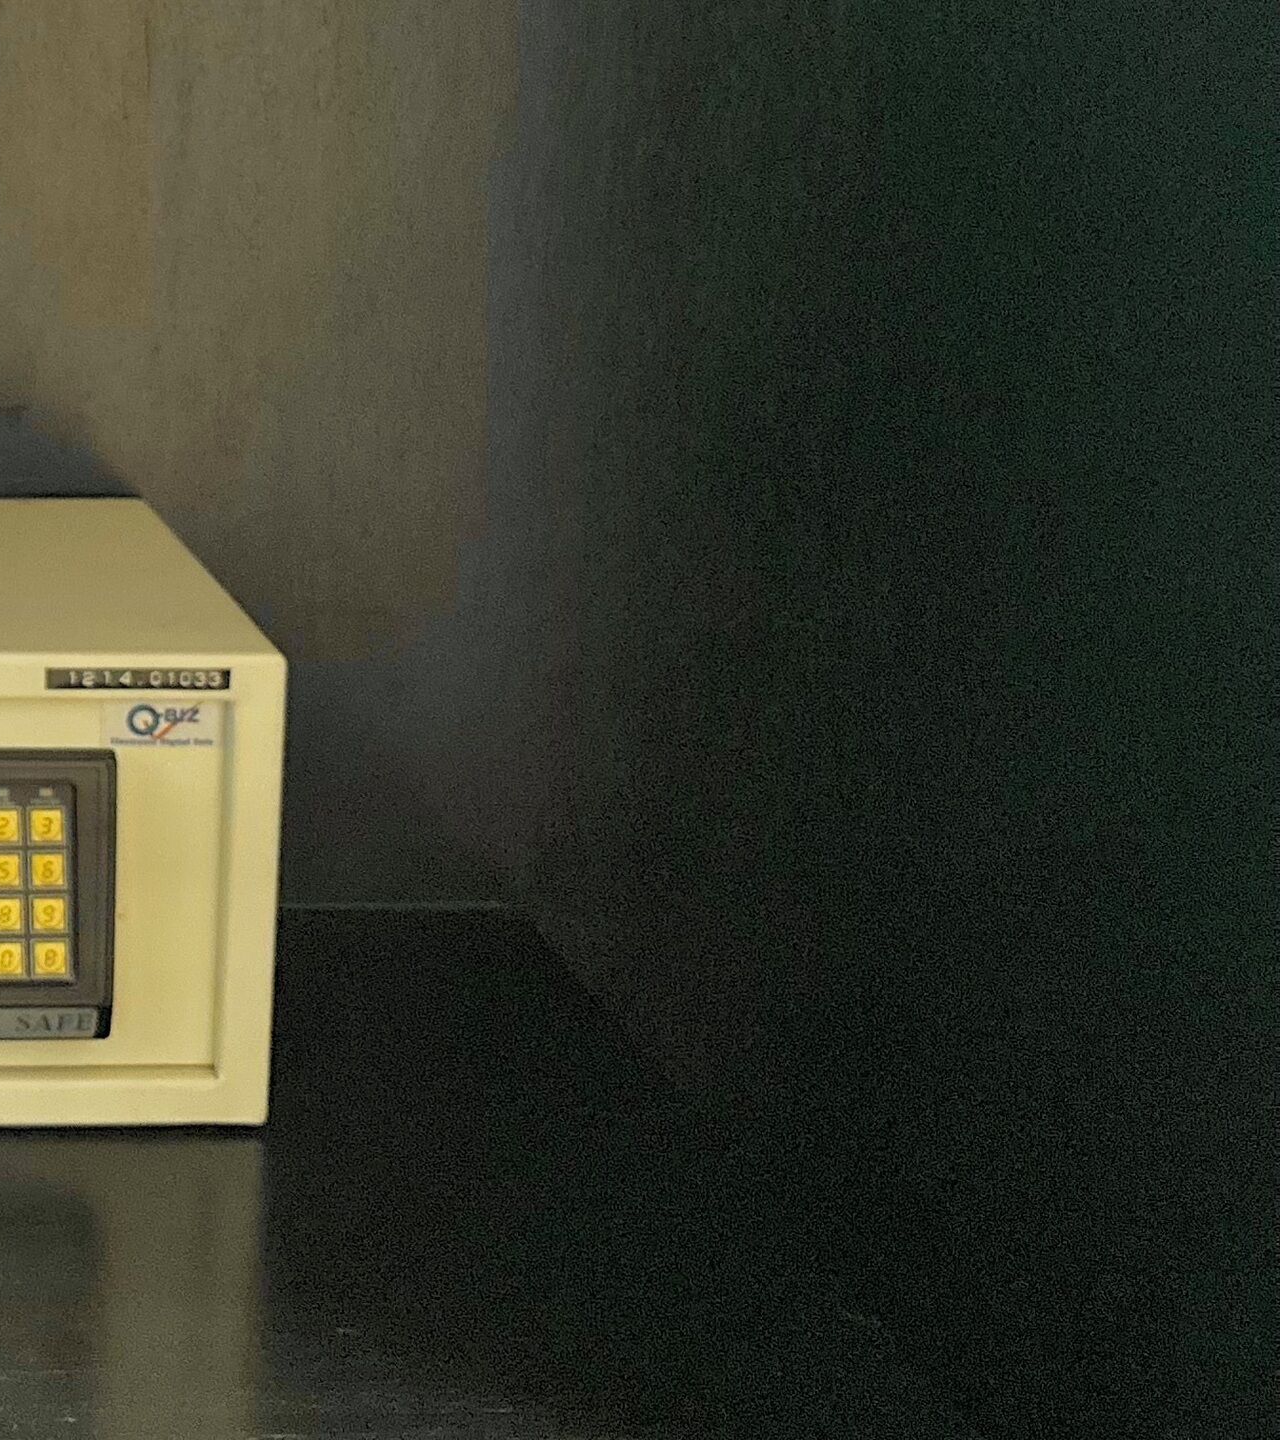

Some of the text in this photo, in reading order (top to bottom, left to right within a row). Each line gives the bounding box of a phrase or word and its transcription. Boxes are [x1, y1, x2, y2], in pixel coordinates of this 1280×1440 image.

[41, 816, 53, 834] 3
[0, 860, 10, 878] 5
[15, 1012, 95, 1034] SAFE
